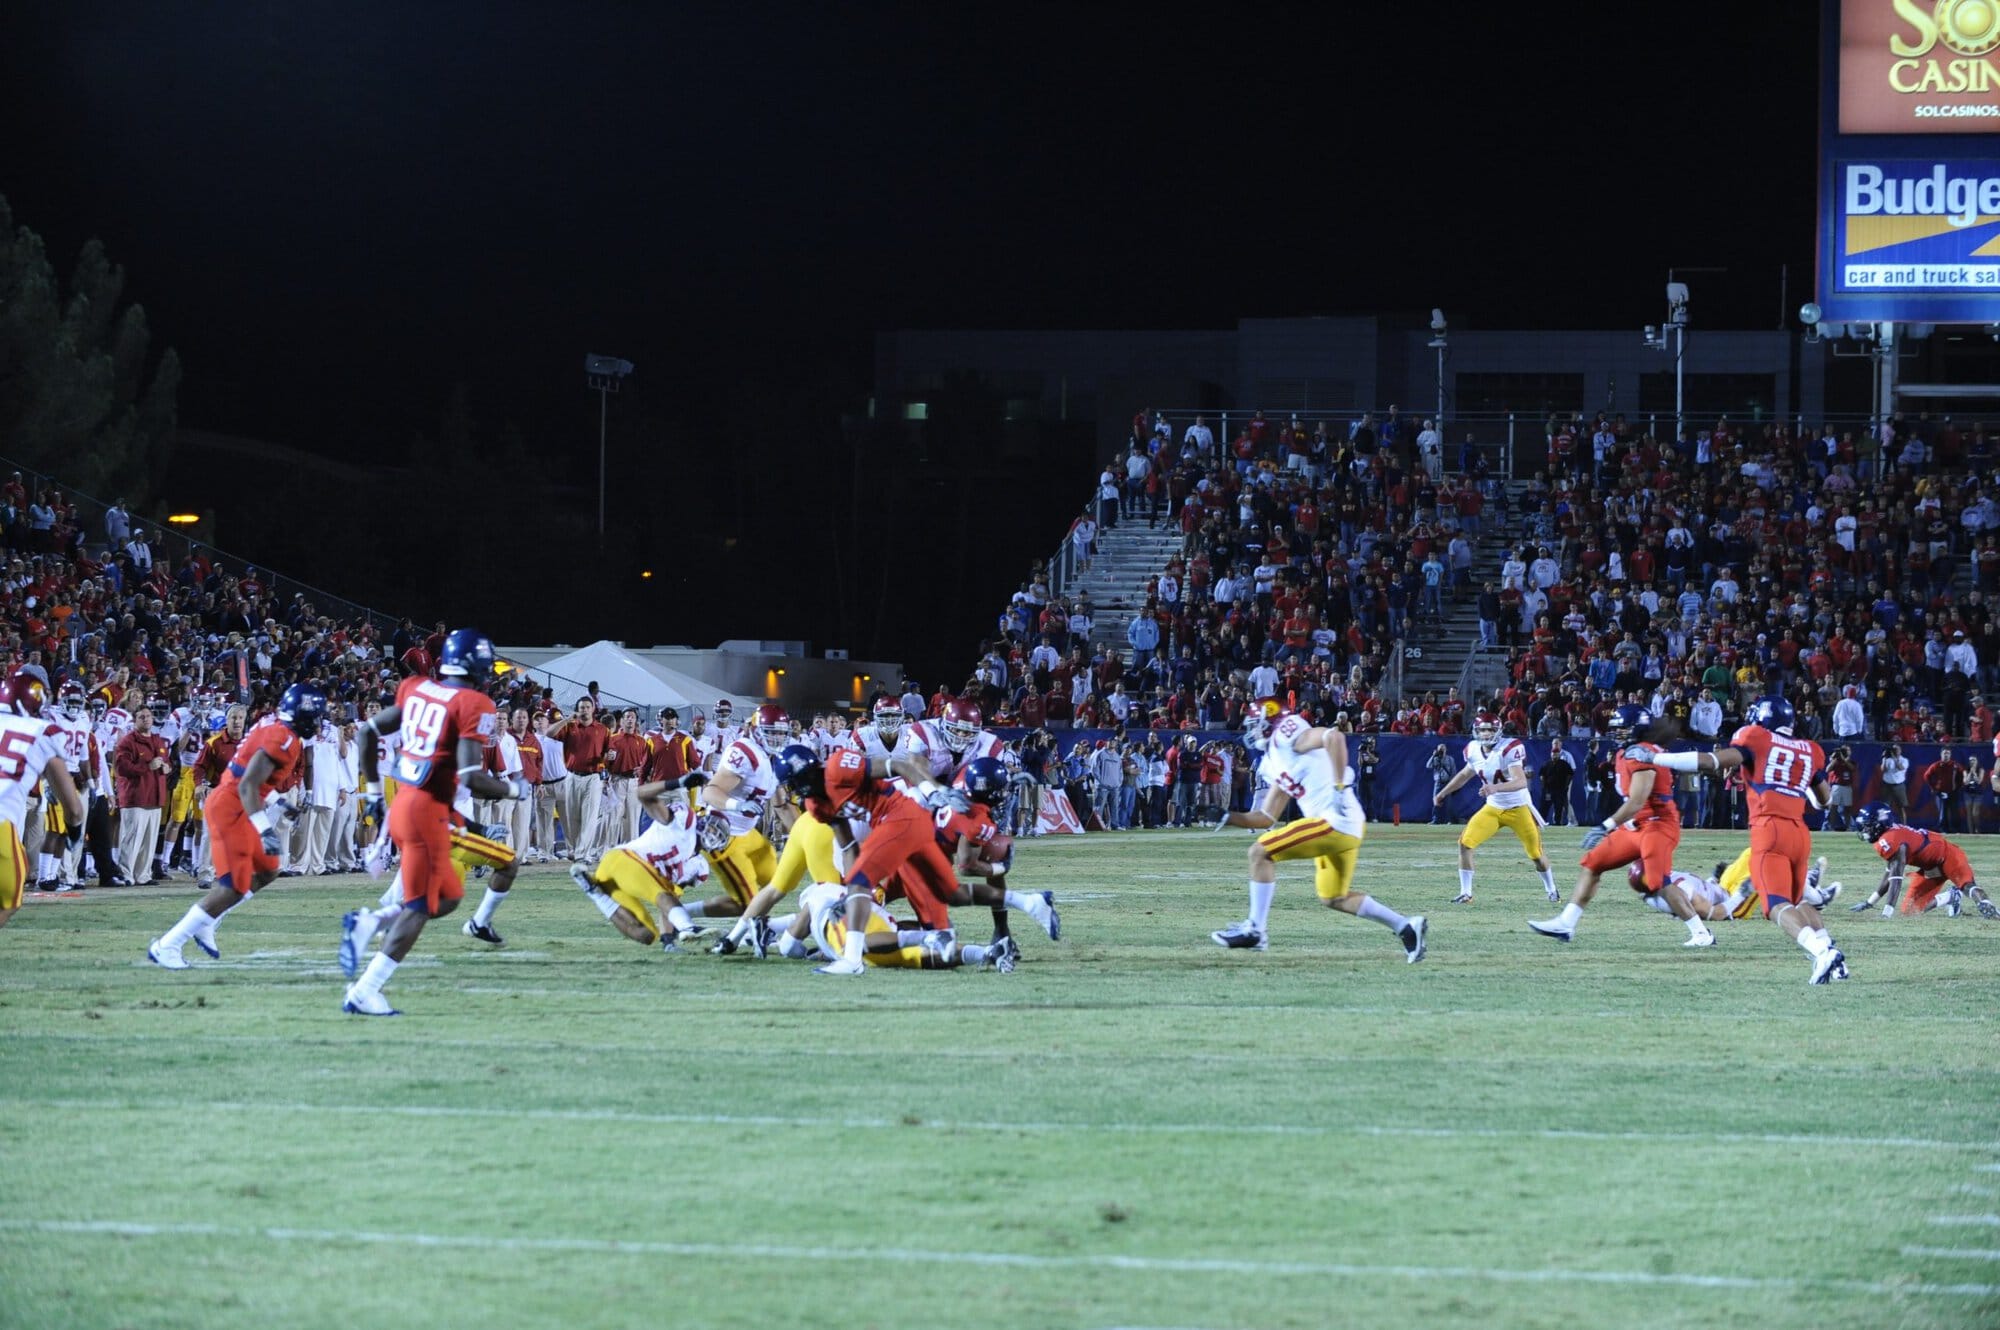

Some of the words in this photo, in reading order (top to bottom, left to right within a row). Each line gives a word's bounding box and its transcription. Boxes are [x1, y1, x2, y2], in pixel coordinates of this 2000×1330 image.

[1849, 270, 1877, 284] car
[1884, 267, 1916, 284] and
[1923, 267, 1969, 284] truck
[1404, 647, 1422, 658] 26
[400, 695, 448, 758] 89
[1764, 745, 1812, 794] 81
